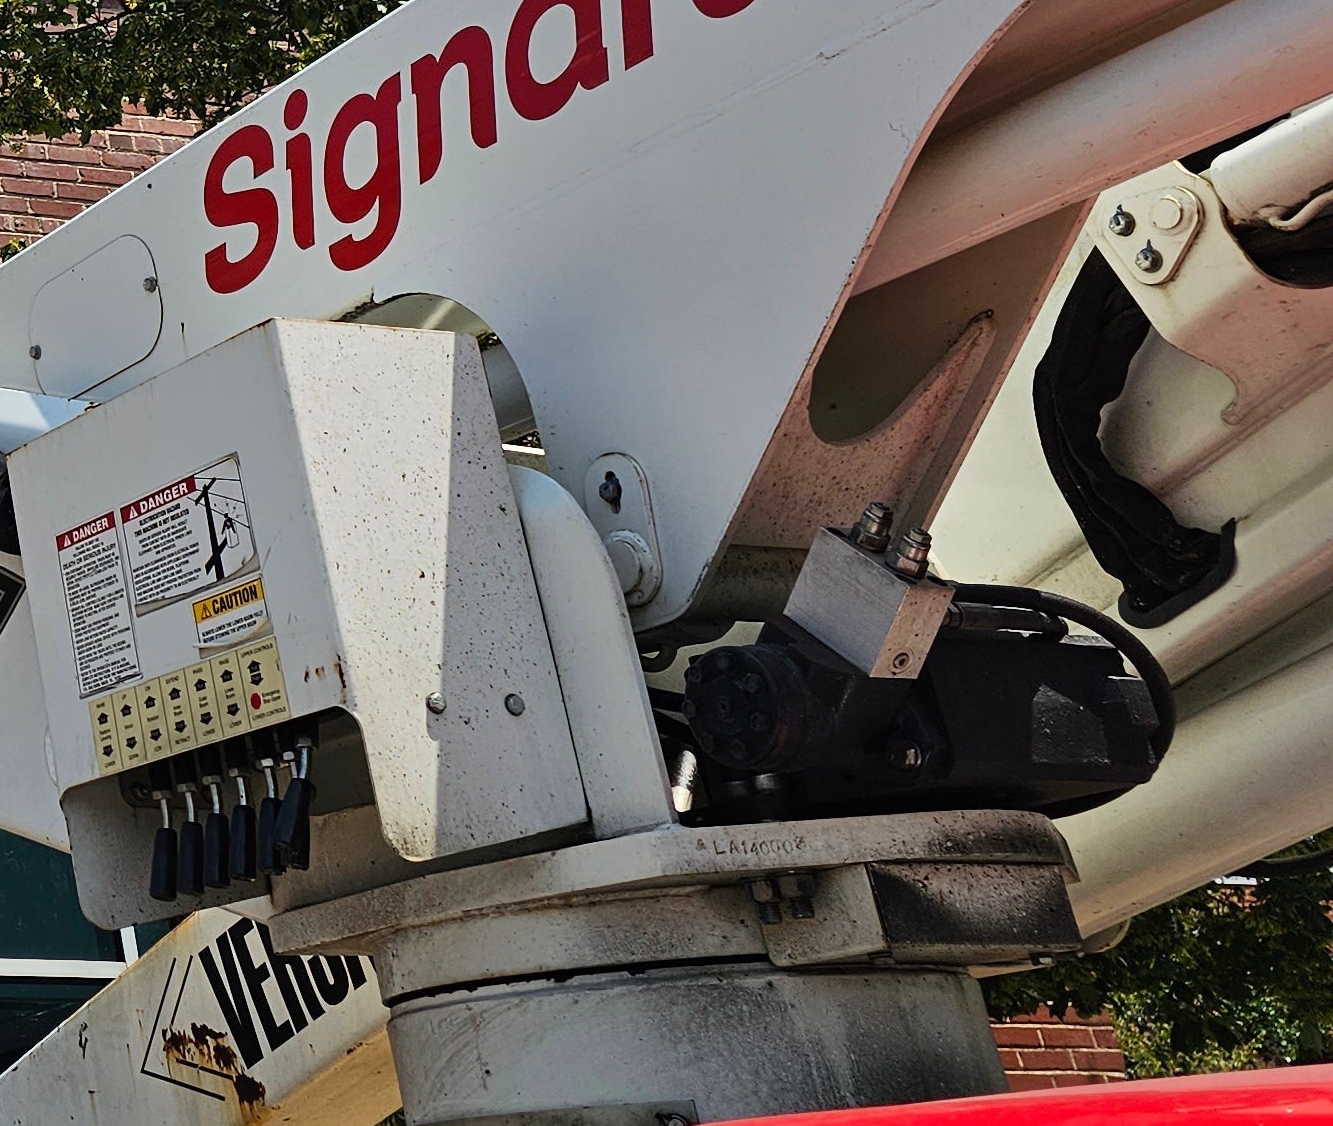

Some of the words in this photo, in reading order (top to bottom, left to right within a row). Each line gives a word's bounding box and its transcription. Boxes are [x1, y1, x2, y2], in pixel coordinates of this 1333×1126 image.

[139, 481, 189, 514] DANGER
[73, 517, 109, 542] DANGER
[211, 584, 258, 615] CAUTION
